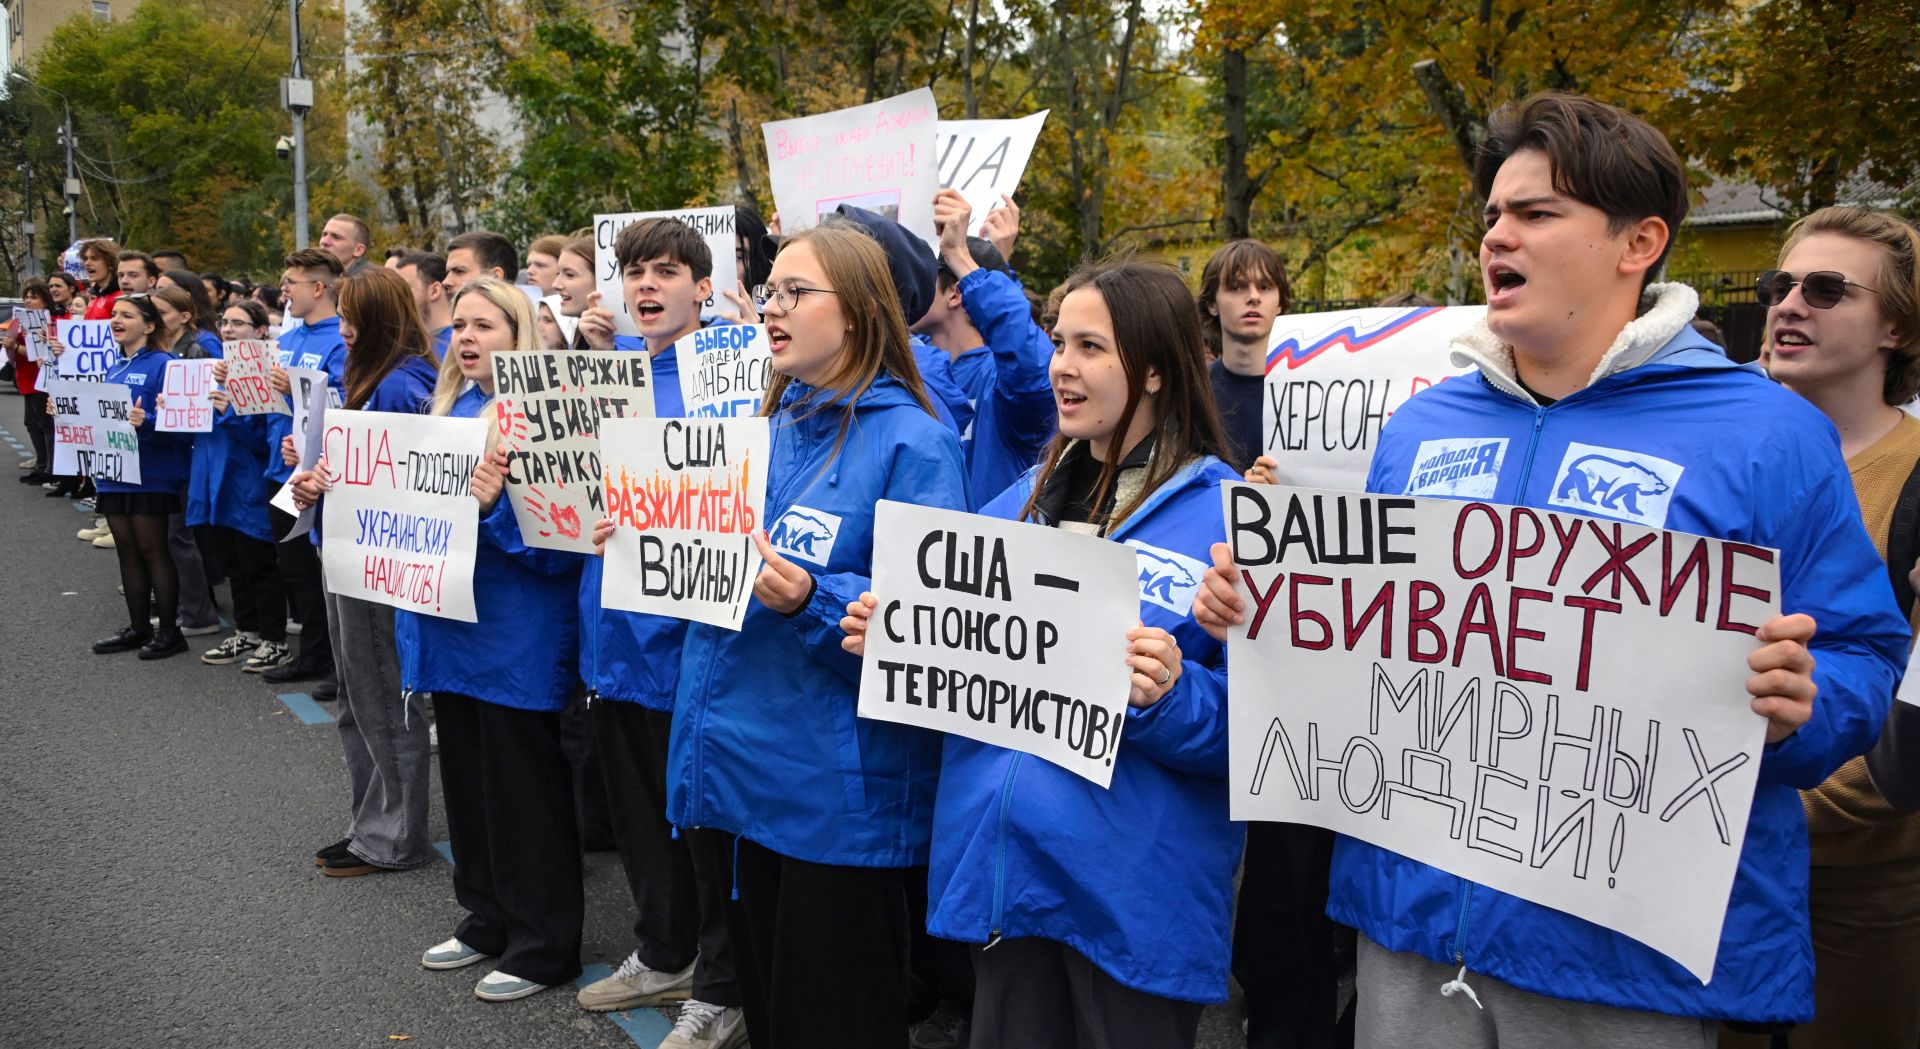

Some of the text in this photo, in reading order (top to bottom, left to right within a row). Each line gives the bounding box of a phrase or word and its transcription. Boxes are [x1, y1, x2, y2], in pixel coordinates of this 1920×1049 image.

[936, 134, 1012, 191] ША
[68, 324, 115, 349] США
[694, 325, 757, 354] ВЫБОР
[167, 363, 213, 396] США
[495, 355, 645, 394] ВАШЕ ОРУЖИЕ
[507, 449, 601, 485] СТАРИКО
[663, 420, 727, 471] США
[356, 509, 453, 556] УКРАИНСКИХ
[605, 482, 755, 535] РАЗЖИГАТЕЛЬ
[364, 554, 446, 613] НАЦИСТОВ!
[916, 529, 1012, 602] США
[1230, 486, 1775, 636] ВАШЕ ОРУЖИЕ
[883, 599, 1059, 665] СПОНСОР
[1241, 569, 1623, 692] УБИВАЕТ
[877, 659, 1123, 768] ТЕРРОРИСТОВ!
[1369, 661, 1749, 846] МИРНЫХ
[1250, 717, 1626, 890] ЛЮДЕЙ!
